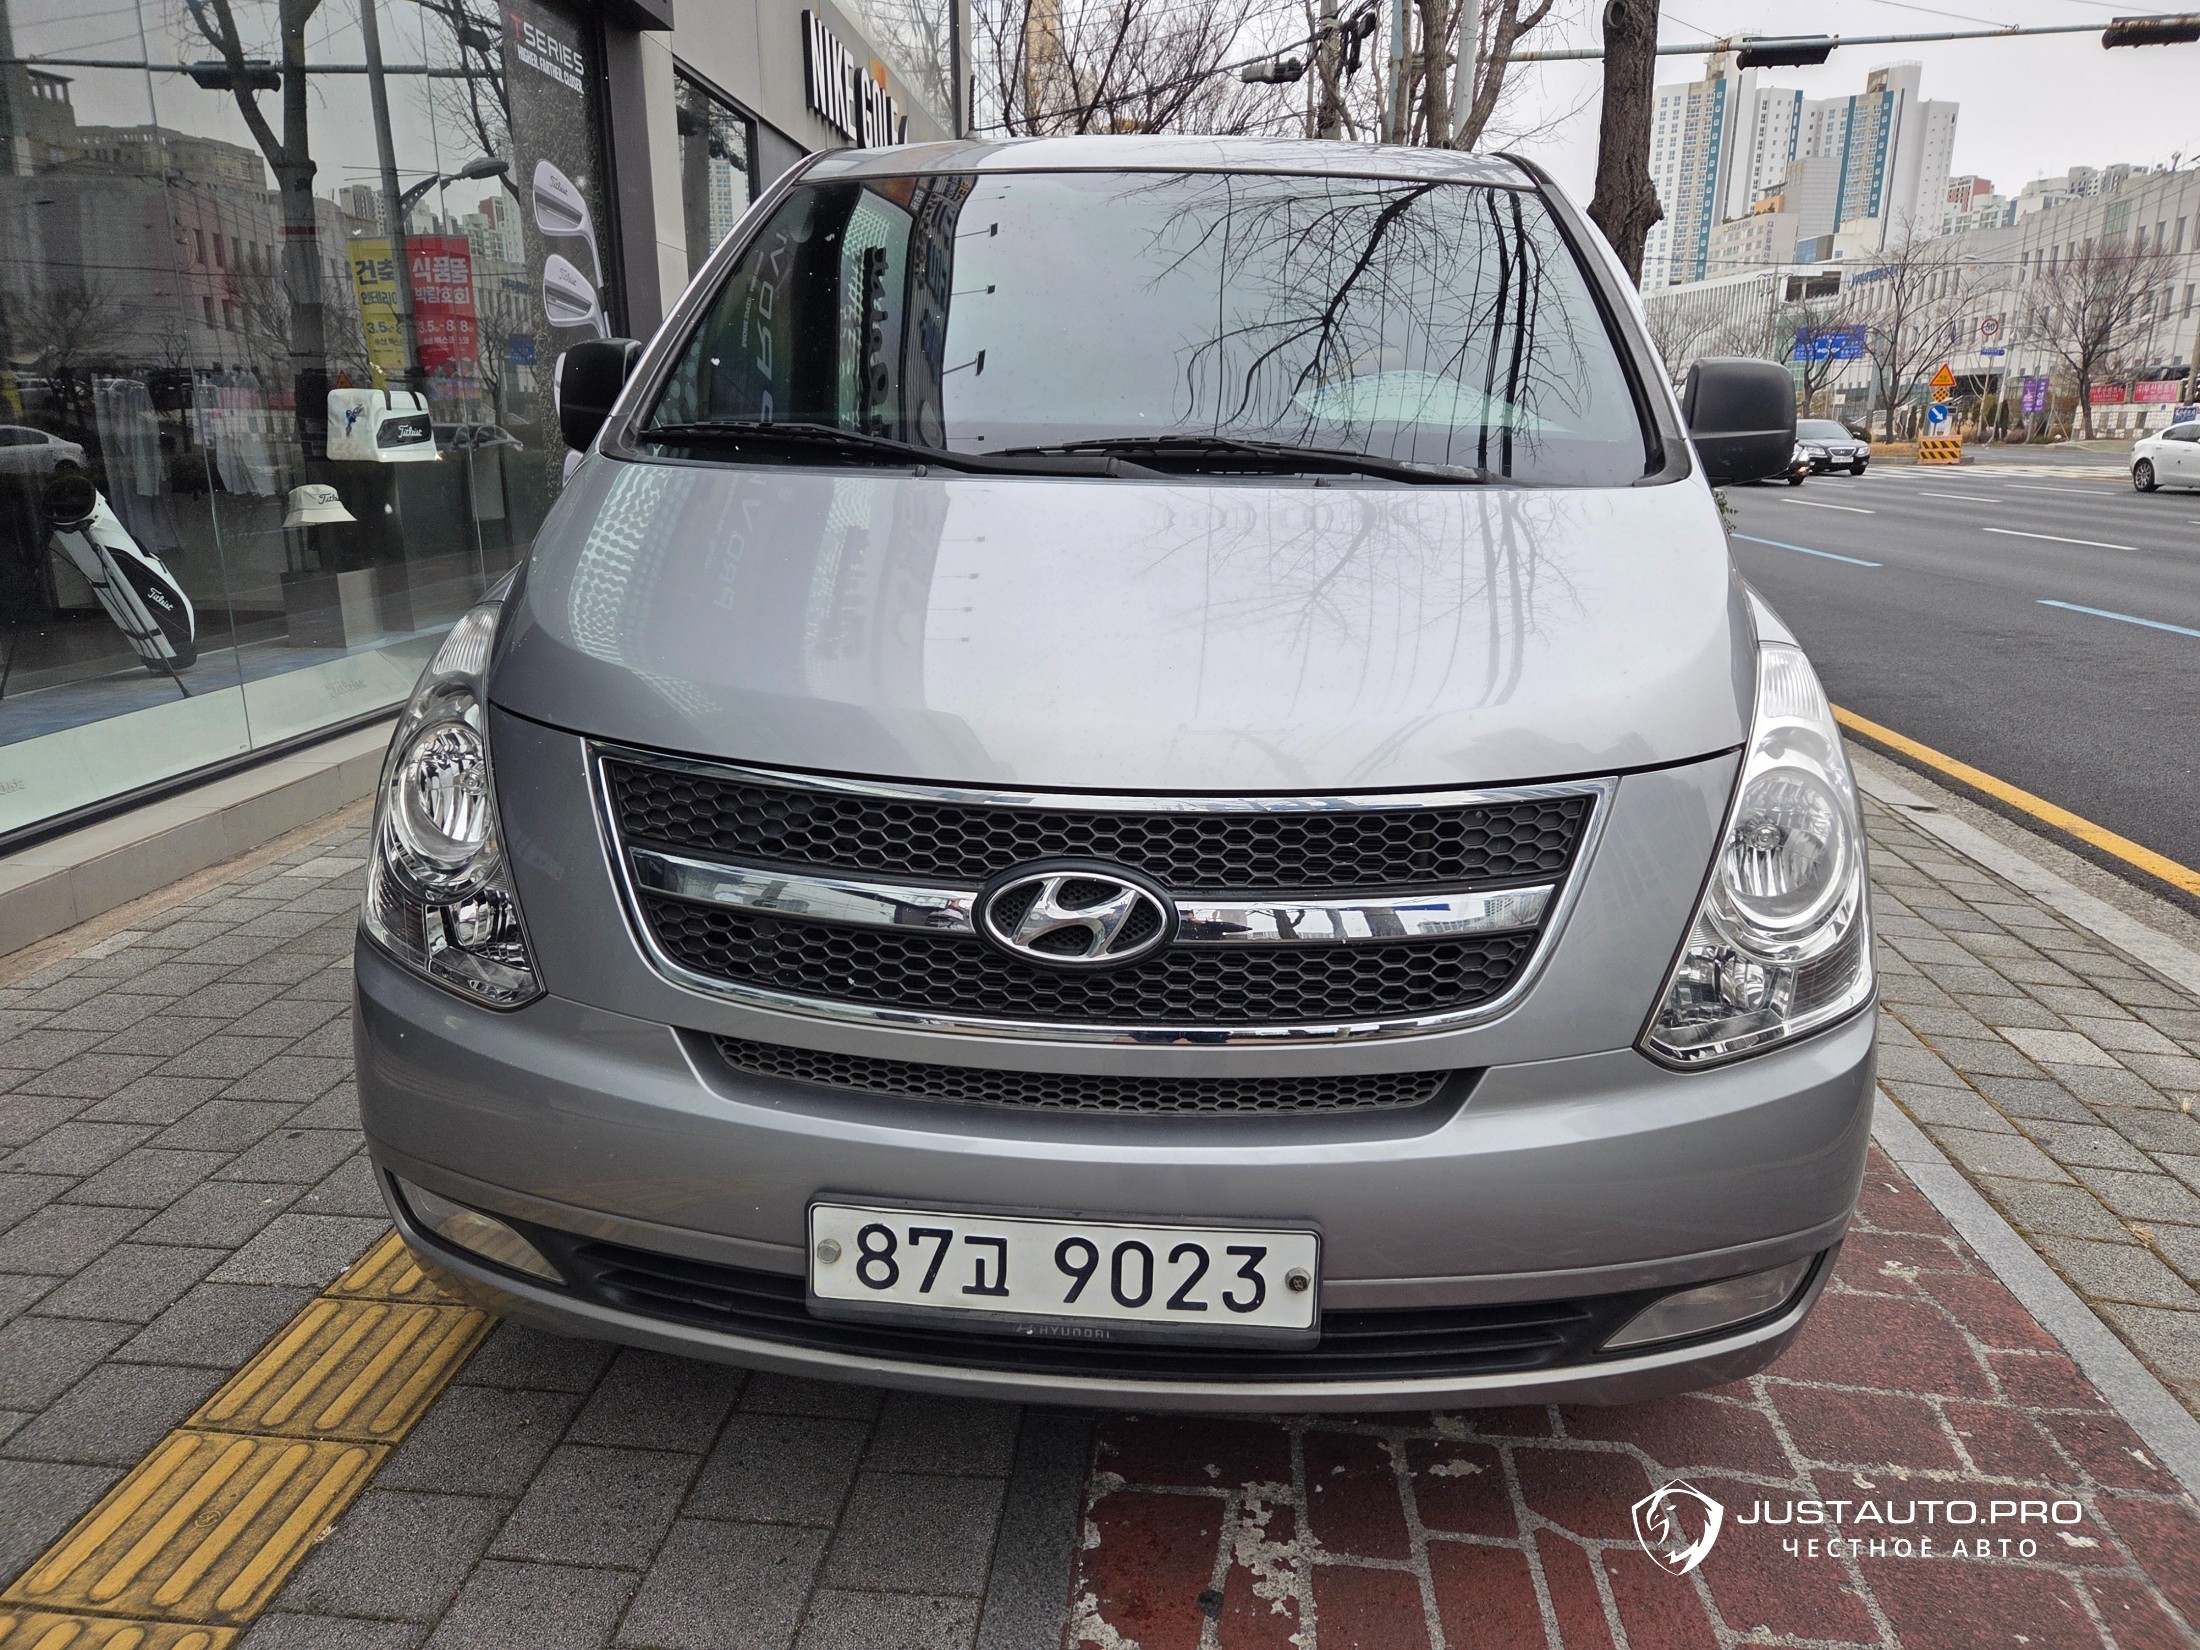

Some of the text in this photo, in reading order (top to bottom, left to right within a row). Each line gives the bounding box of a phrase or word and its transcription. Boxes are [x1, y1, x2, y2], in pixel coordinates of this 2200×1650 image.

[802, 9, 857, 142] NIKE
[855, 1223, 1268, 1314] 87고 9023
[1039, 1325, 1110, 1339] HYUNDAI
